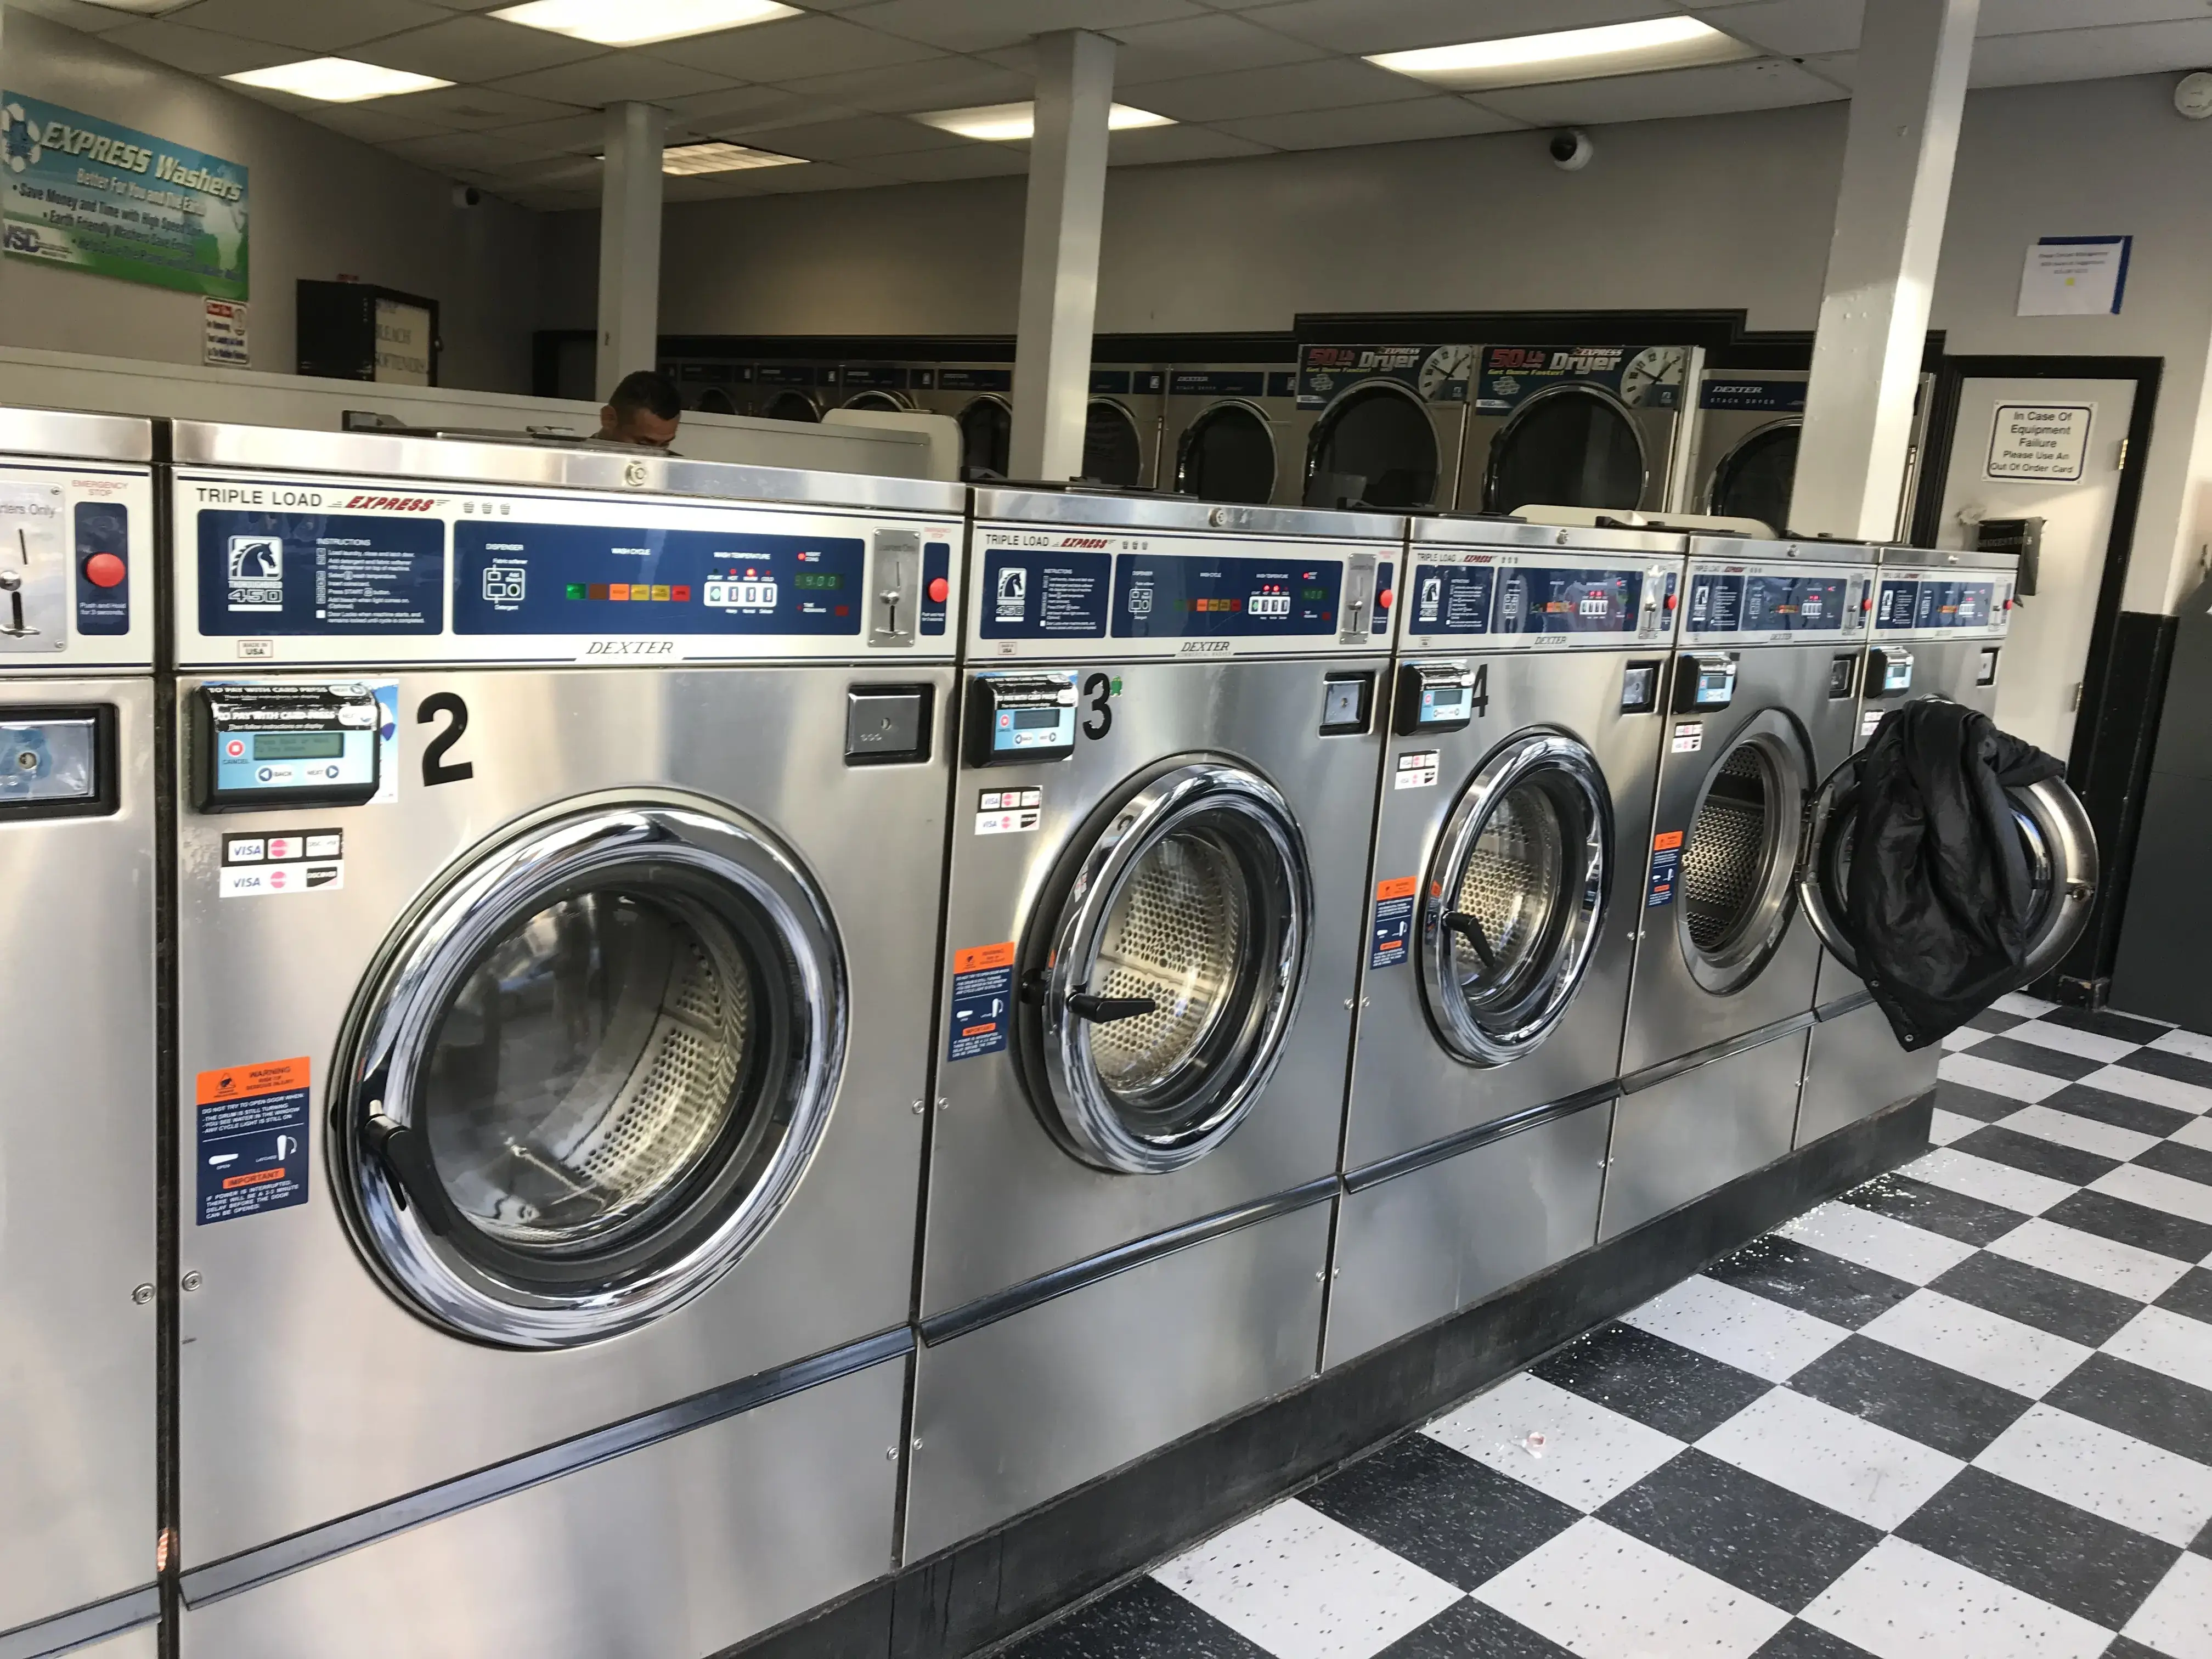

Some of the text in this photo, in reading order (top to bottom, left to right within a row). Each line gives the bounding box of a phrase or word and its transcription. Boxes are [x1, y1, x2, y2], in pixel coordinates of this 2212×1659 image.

[40, 122, 243, 202] EXPRESS Washers
[19, 183, 44, 200] Save
[1357, 352, 1420, 372] Dryer
[1489, 349, 1525, 368] 50
[1549, 353, 1622, 375] Dryer
[1712, 386, 1763, 394] DEXTER
[2014, 411, 2073, 421] In Case Of
[2010, 425, 2072, 437] Equipment
[2018, 438, 2057, 447] Failure
[2002, 450, 2034, 459] Please
[2036, 451, 2054, 460] Use
[1990, 462, 2074, 473] Out Of Order Card
[71, 479, 129, 489] EMERGENCY
[196, 488, 436, 511] TRIPLE LOAD EXPRESS
[28, 503, 54, 518] Only
[986, 534, 1108, 549] TRIPLE LOAD EXPRESS
[1417, 553, 1438, 562] TRIPLE
[228, 589, 283, 603] 450
[996, 606, 1025, 616] 450
[1181, 641, 1230, 652] DEXTER
[1534, 636, 1567, 645] DEXTER
[585, 641, 674, 654] DEXTER
[1471, 663, 1489, 718] 4
[1082, 672, 1113, 741] 3
[416, 691, 473, 787] 2
[234, 845, 262, 856] VISA
[233, 878, 261, 888] VISA
[249, 1066, 291, 1079] WARNING
[232, 1115, 254, 1123] WATER
[274, 1106, 301, 1116] WINDOW
[244, 1107, 261, 1116] STILL
[261, 1103, 289, 1112] TURNING
[266, 1115, 281, 1124] STILL
[229, 1170, 280, 1187] IMPORTANT
[206, 1198, 228, 1207] THERE
[276, 1183, 300, 1193] MINUTE
[215, 1190, 240, 1200] POWER
[229, 1200, 255, 1209] BEFORE
[270, 1192, 290, 1200] DOOR
